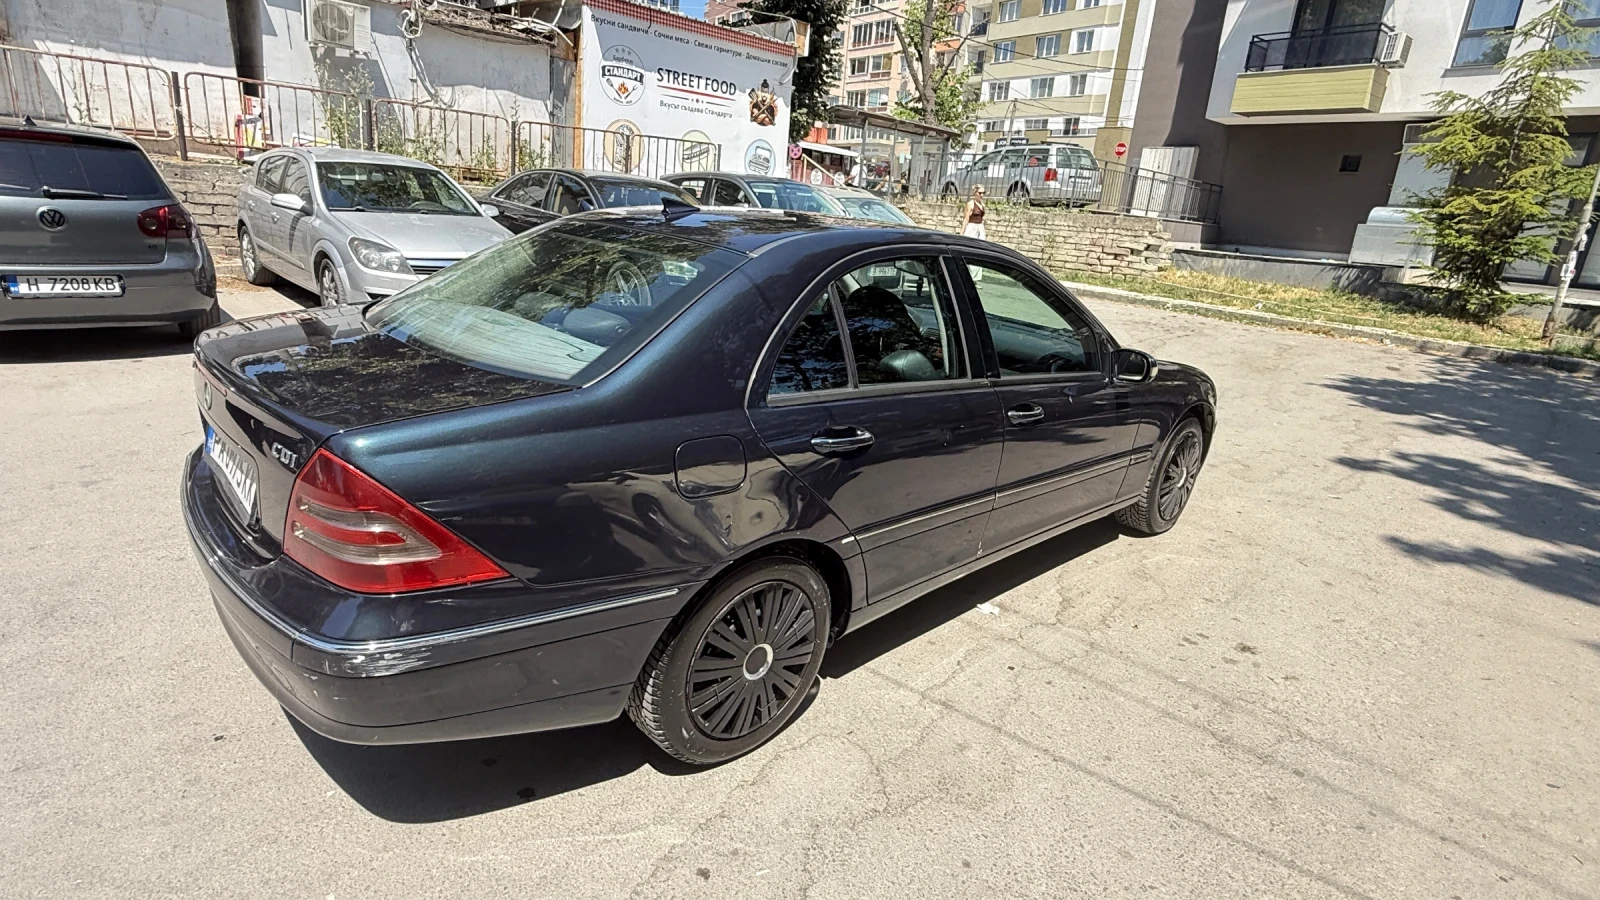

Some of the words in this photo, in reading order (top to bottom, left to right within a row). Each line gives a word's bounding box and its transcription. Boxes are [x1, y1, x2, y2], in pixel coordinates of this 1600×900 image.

[590, 14, 616, 27] Вкусни
[617, 22, 649, 35] сандвичи
[653, 29, 674, 42] Сочни
[674, 36, 690, 45] меса
[693, 39, 713, 50] Свежи
[604, 65, 641, 82] СТАНДАРТ
[656, 67, 703, 90] STREET
[705, 77, 737, 96] FOOD
[271, 442, 298, 468] CDI
